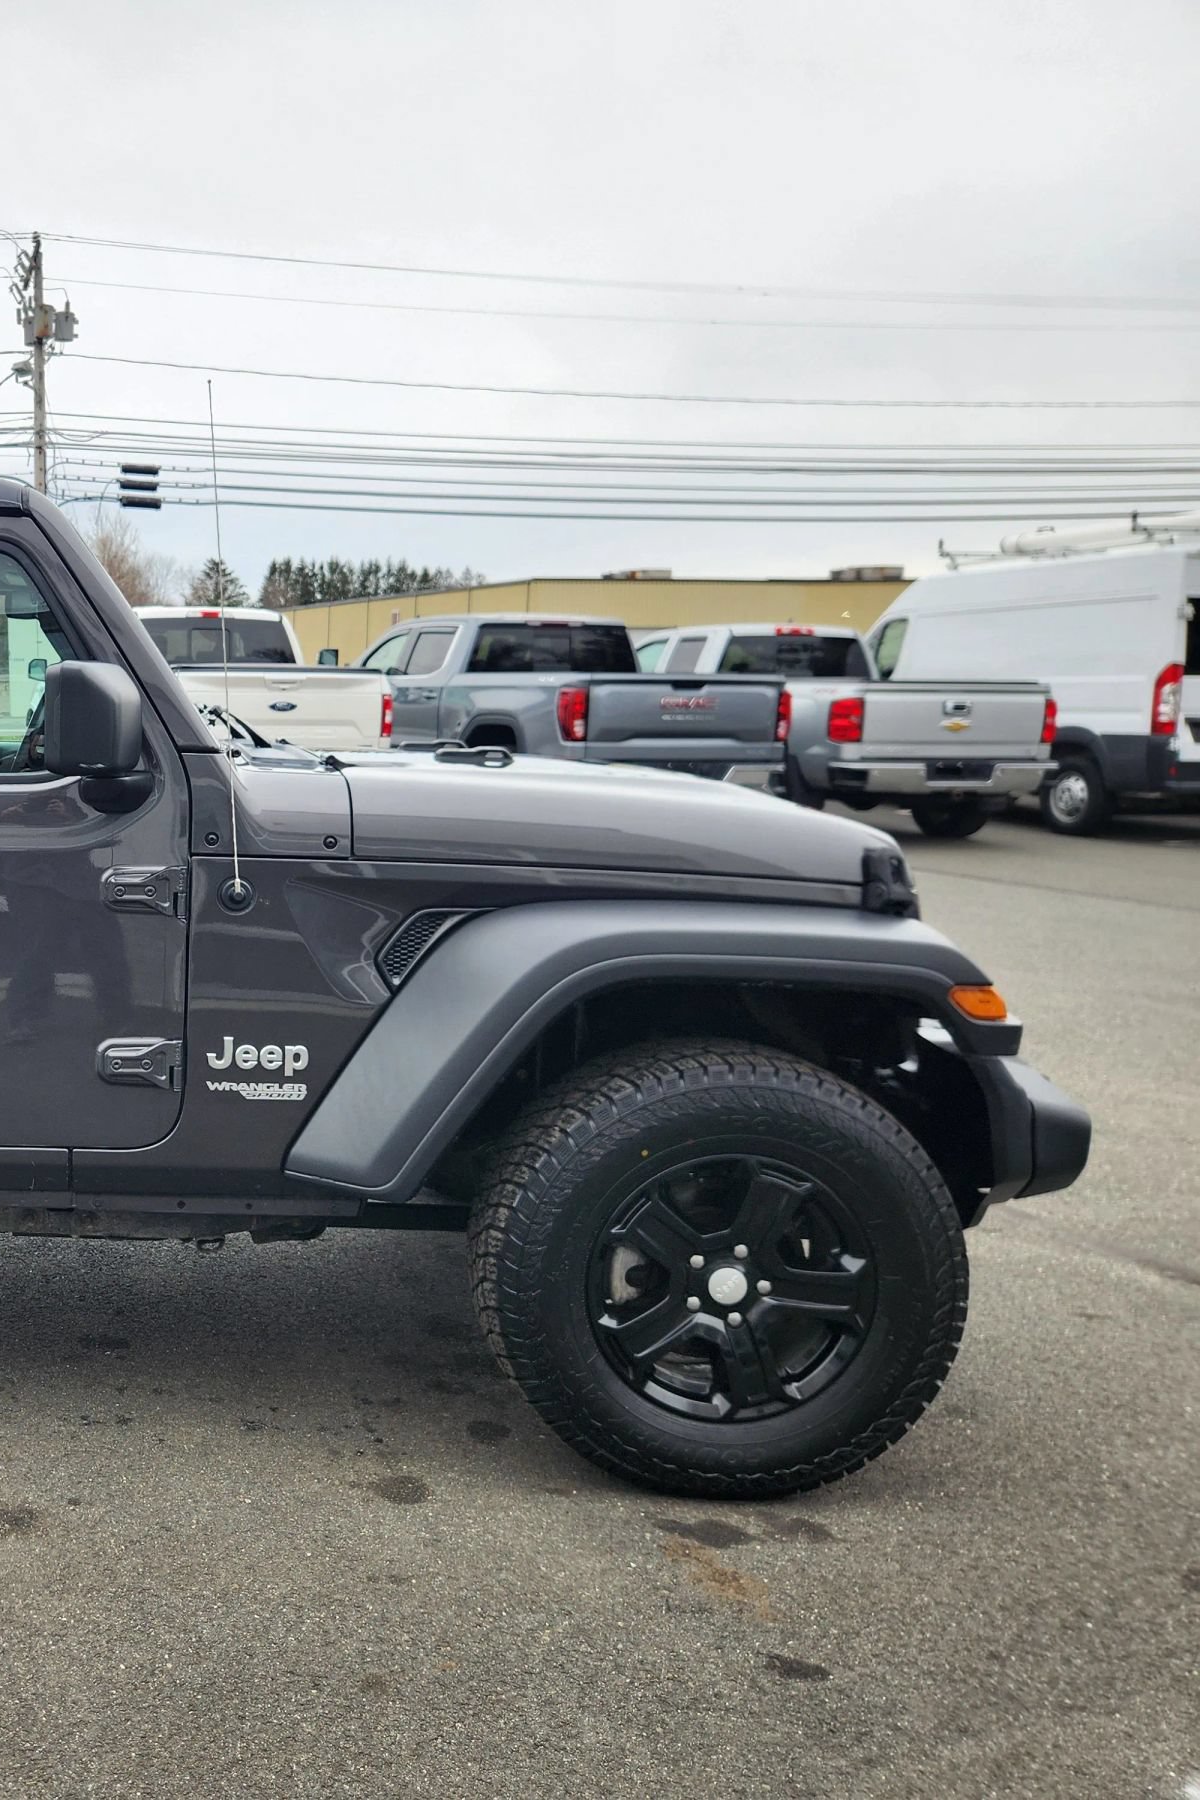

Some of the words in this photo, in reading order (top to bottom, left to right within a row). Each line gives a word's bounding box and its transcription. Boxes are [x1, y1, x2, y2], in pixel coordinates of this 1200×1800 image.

[206, 1036, 309, 1076] Jeep
[206, 1081, 307, 1092] WRANGLER
[243, 1091, 304, 1099] SPORT
